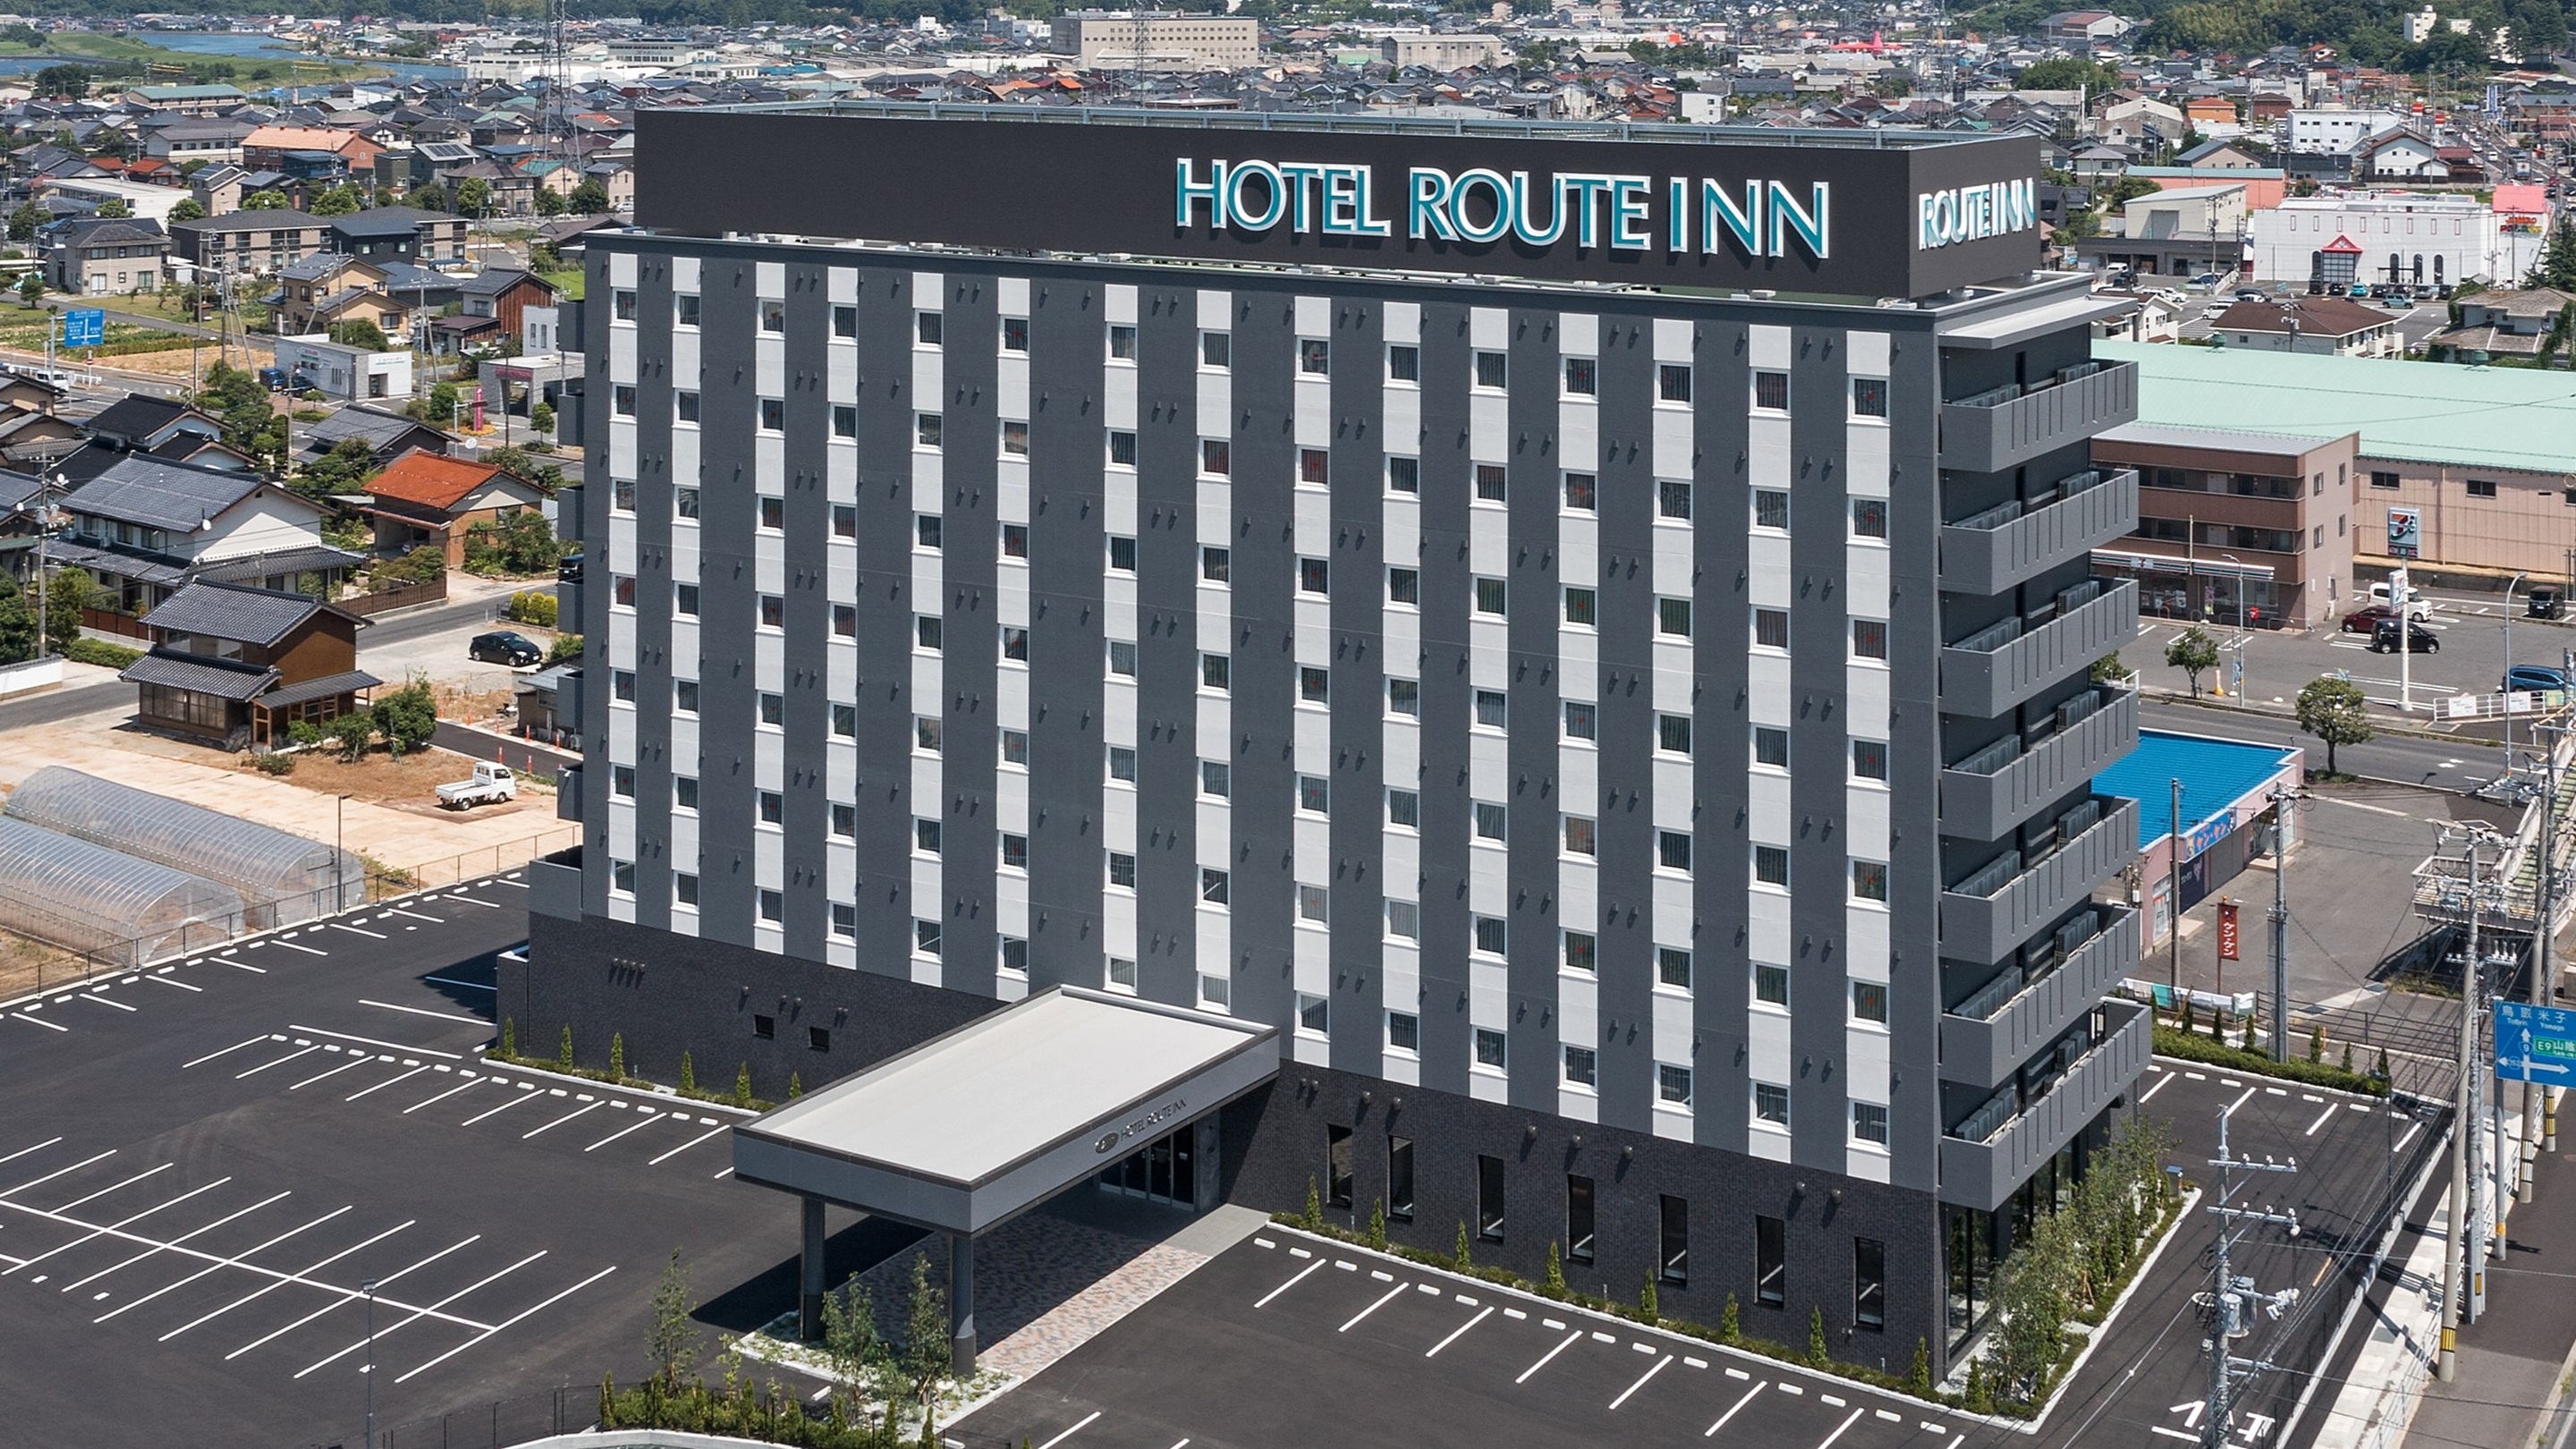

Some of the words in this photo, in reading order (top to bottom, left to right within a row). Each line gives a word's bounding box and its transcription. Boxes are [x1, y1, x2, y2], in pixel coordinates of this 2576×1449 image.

[1176, 157, 1391, 237] HOTEL
[1409, 166, 1651, 251] ROUTE
[1669, 177, 1829, 259] INN
[1919, 183, 1990, 250] ROUTE
[1992, 177, 2035, 236] INN
[2503, 1005, 2531, 1018] 鳥取
[2538, 1010, 2565, 1022] 米子
[2523, 1044, 2529, 1052] 9
[2538, 1040, 2552, 1051] E9
[2554, 1040, 2576, 1052] 山陰
[1121, 1119, 1145, 1140] HOTEL
[1147, 1104, 1172, 1126] ROUTE
[2169, 1400, 2276, 1443] 止レ
